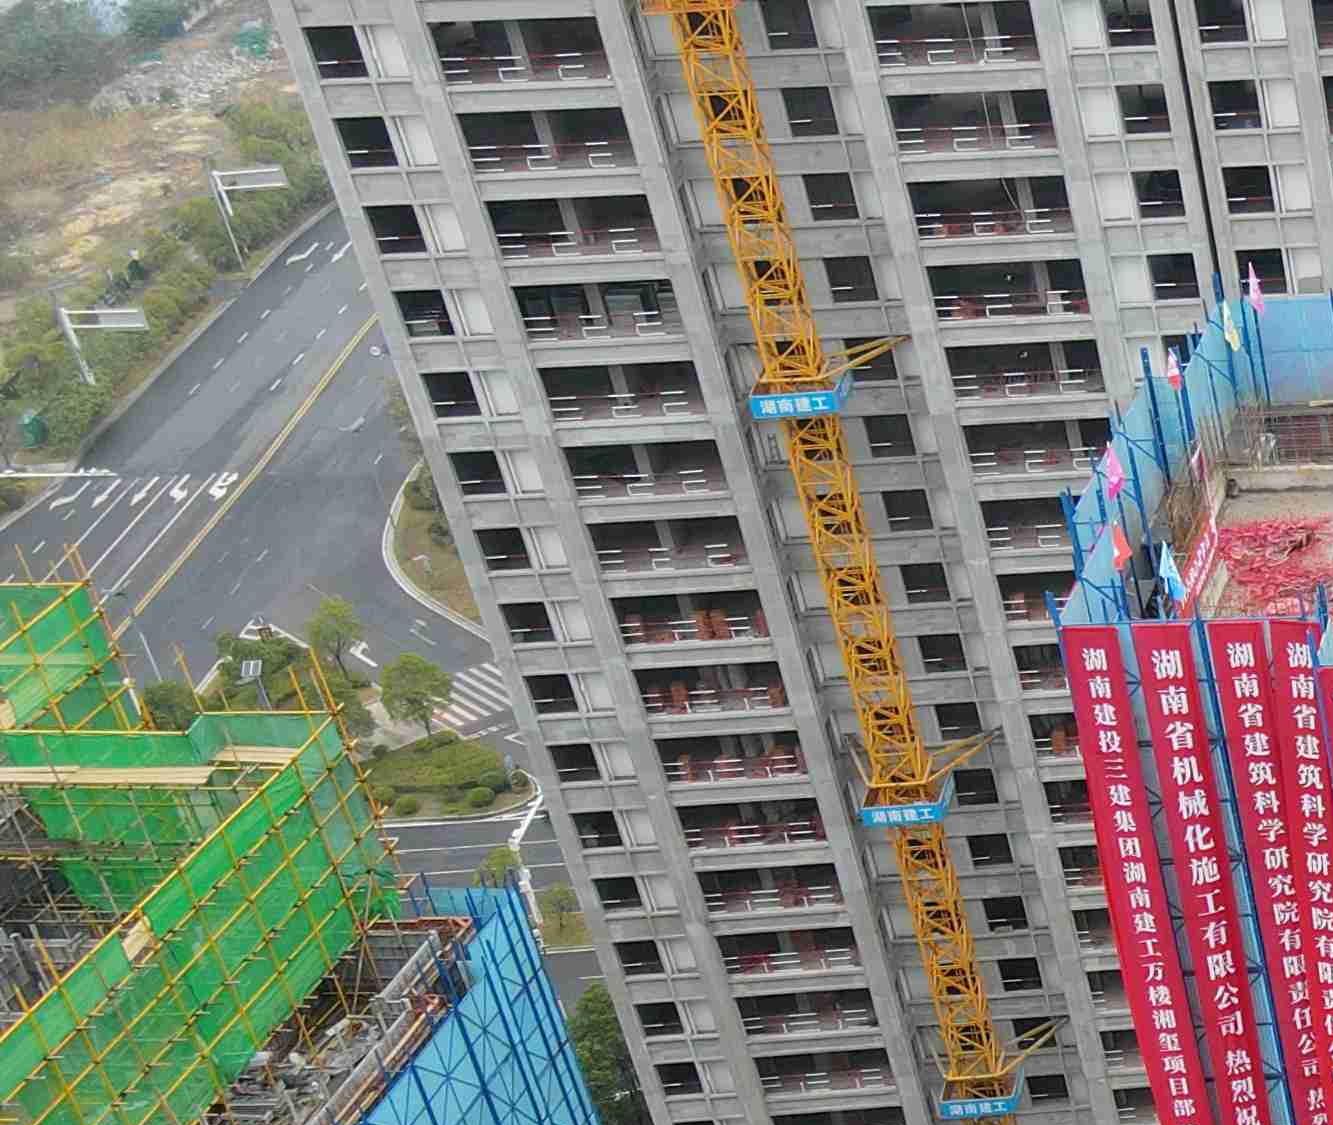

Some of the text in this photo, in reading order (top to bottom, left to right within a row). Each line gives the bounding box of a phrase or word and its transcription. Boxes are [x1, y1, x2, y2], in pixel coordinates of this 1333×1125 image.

[760, 396, 829, 415] 湖南建工
[1082, 648, 1196, 1117] 湖南建投三建集团湖南建工万楼湘玺项目部
[1152, 649, 1244, 1036] 湖南省机械化施工有限公司
